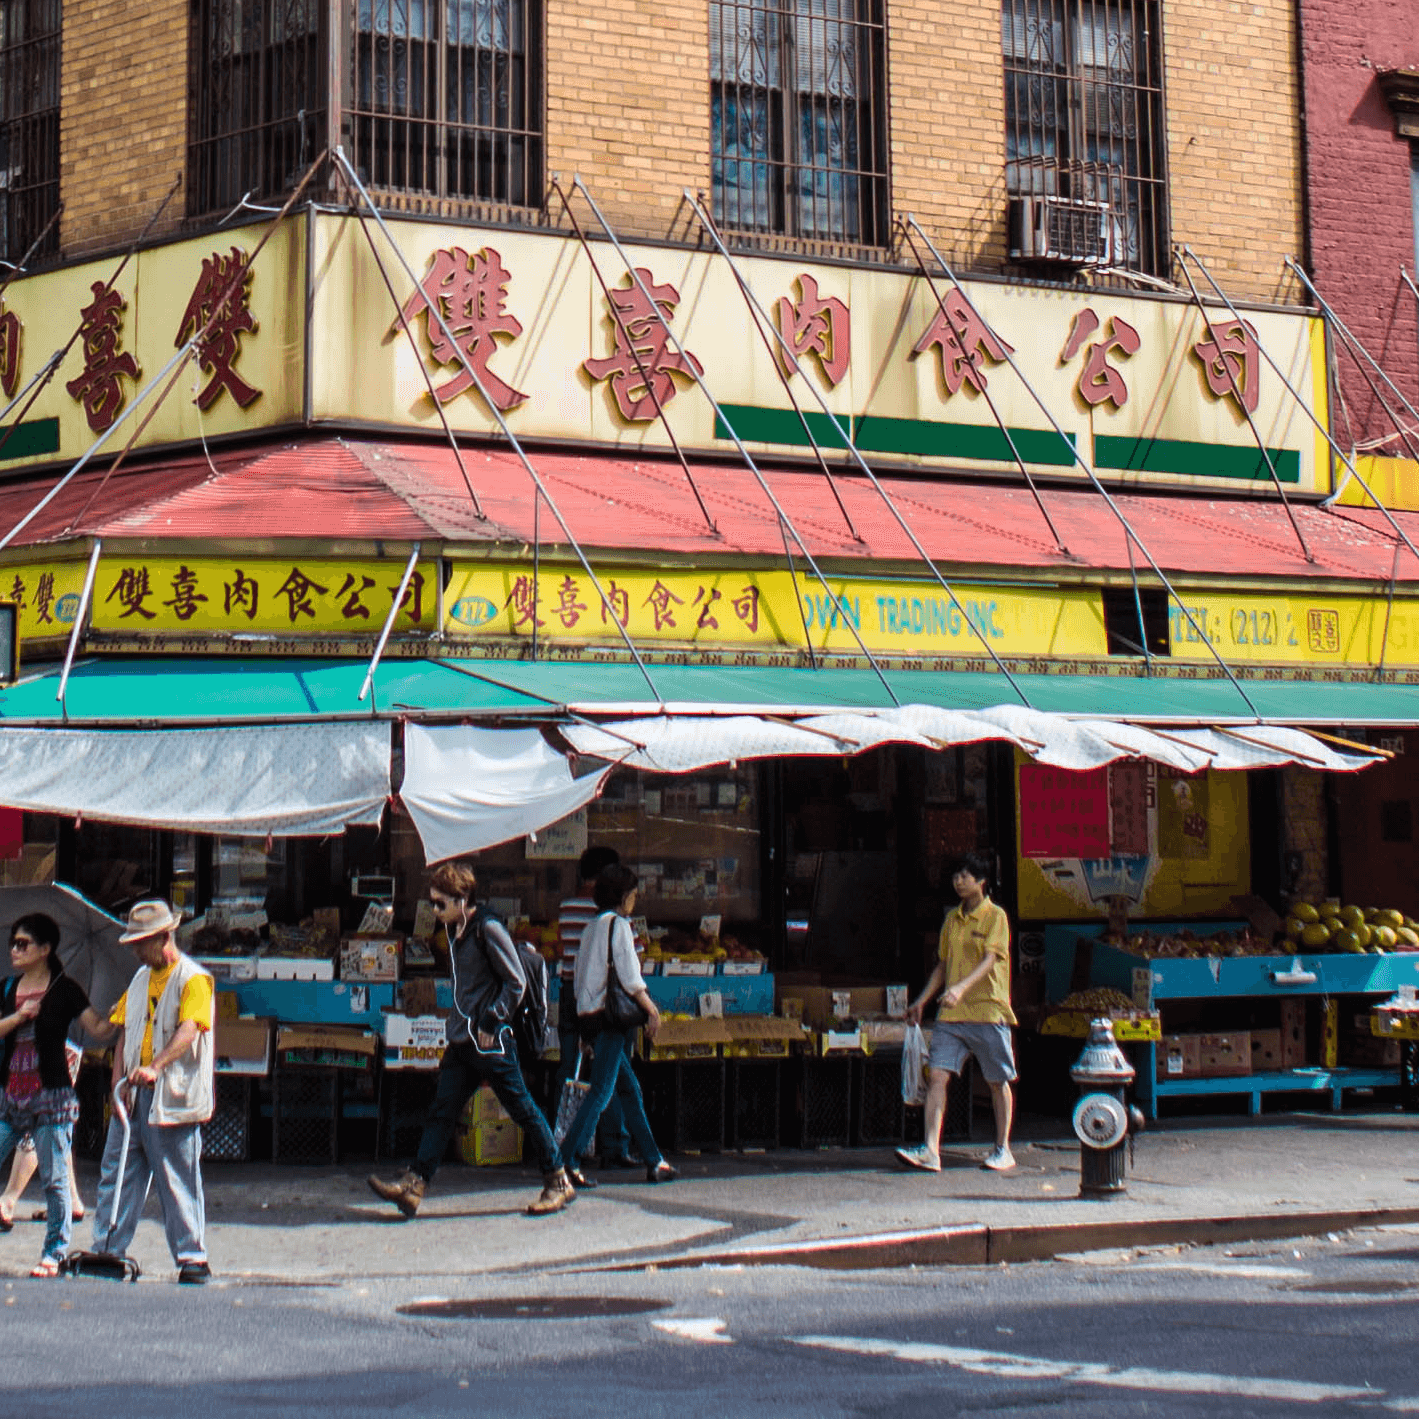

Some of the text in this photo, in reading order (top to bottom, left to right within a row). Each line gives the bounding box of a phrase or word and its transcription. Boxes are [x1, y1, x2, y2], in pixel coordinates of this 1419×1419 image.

[389, 245, 1263, 426] 雙喜肉食公司
[104, 565, 426, 624] 雙喜肉食公司
[503, 574, 761, 633] 雙喜肉食公司
[875, 595, 961, 637] TRADING
[967, 599, 1004, 639] INC.
[1169, 604, 1221, 644] TEL:
[1229, 605, 1279, 647] (212)
